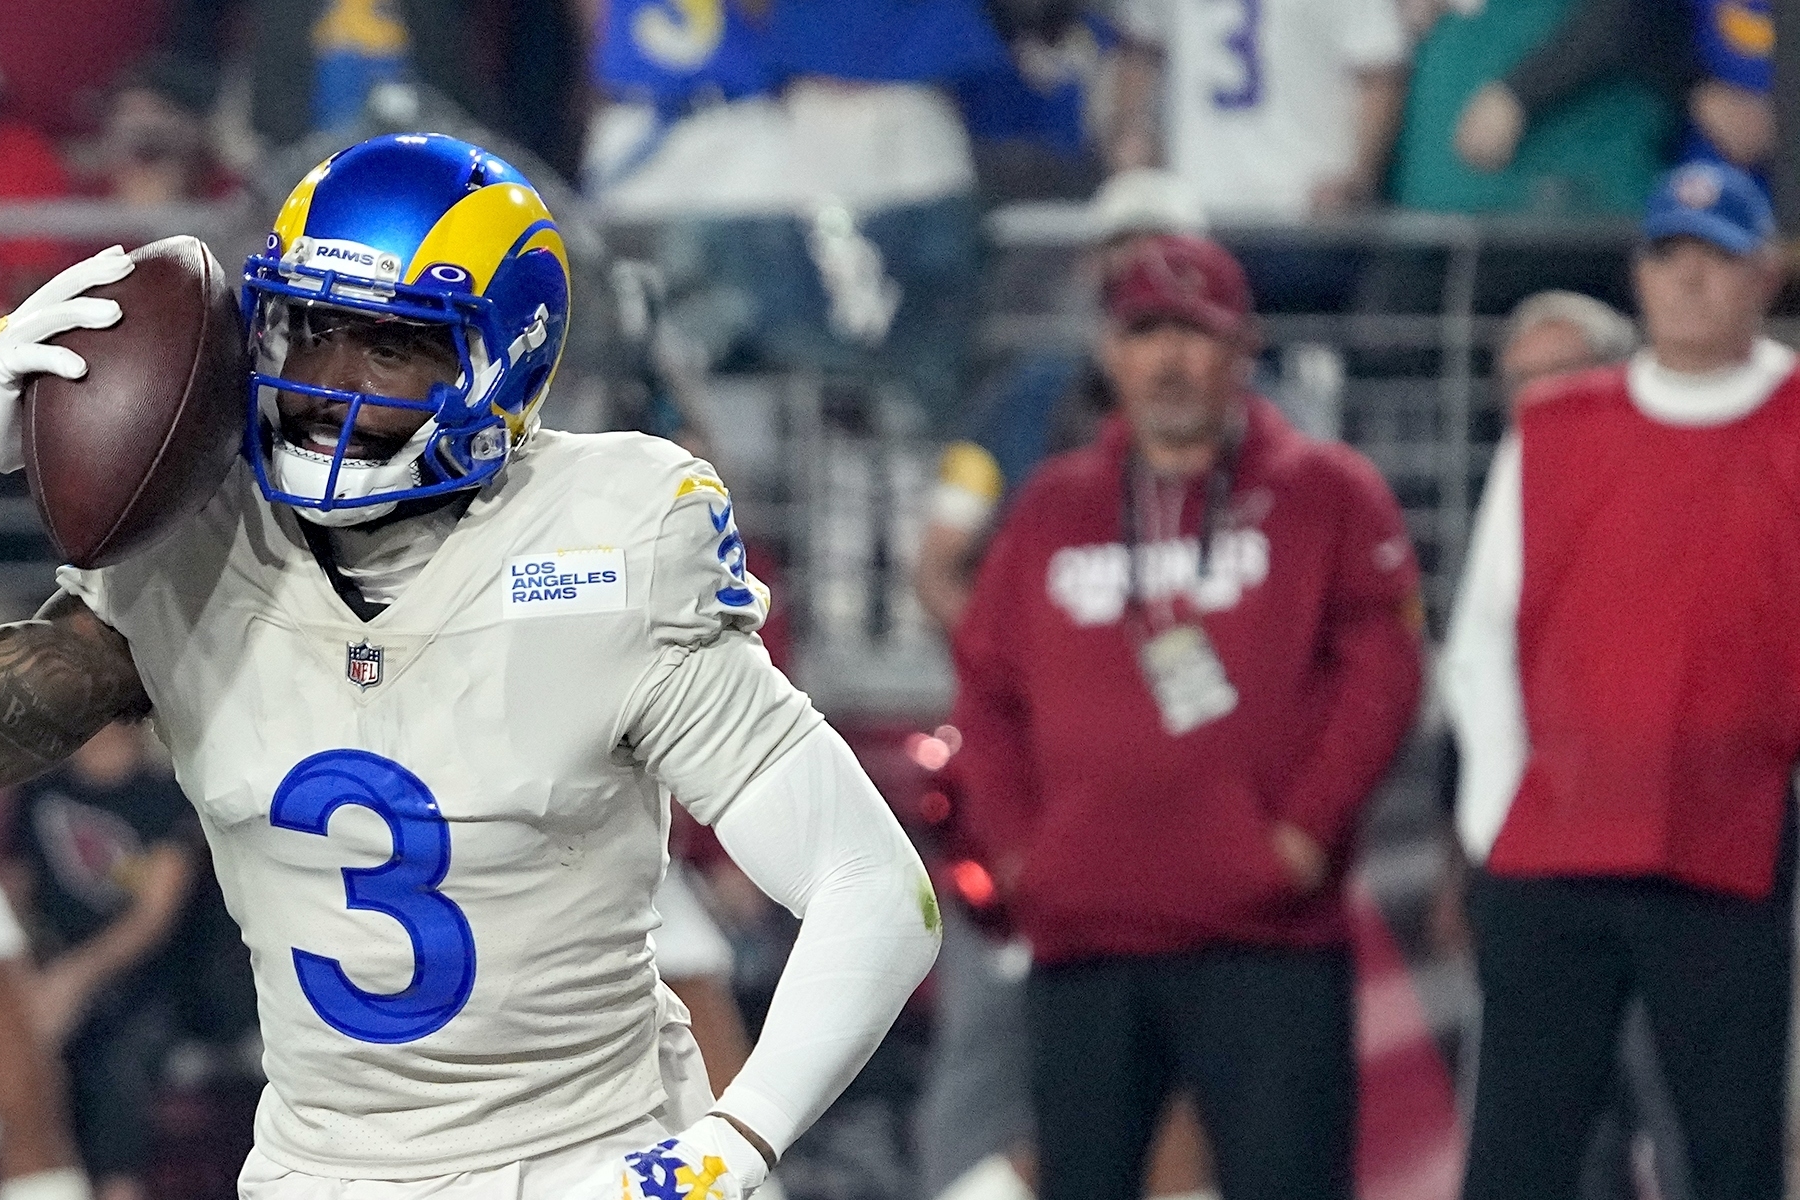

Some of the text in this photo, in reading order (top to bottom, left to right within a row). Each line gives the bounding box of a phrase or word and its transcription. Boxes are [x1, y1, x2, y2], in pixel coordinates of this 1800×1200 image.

[316, 246, 374, 265] RAMS
[512, 561, 556, 577] LOS
[512, 570, 617, 590] ANGELES
[512, 587, 577, 603] RAMS
[351, 661, 377, 682] NFL
[270, 748, 477, 1044] 3
